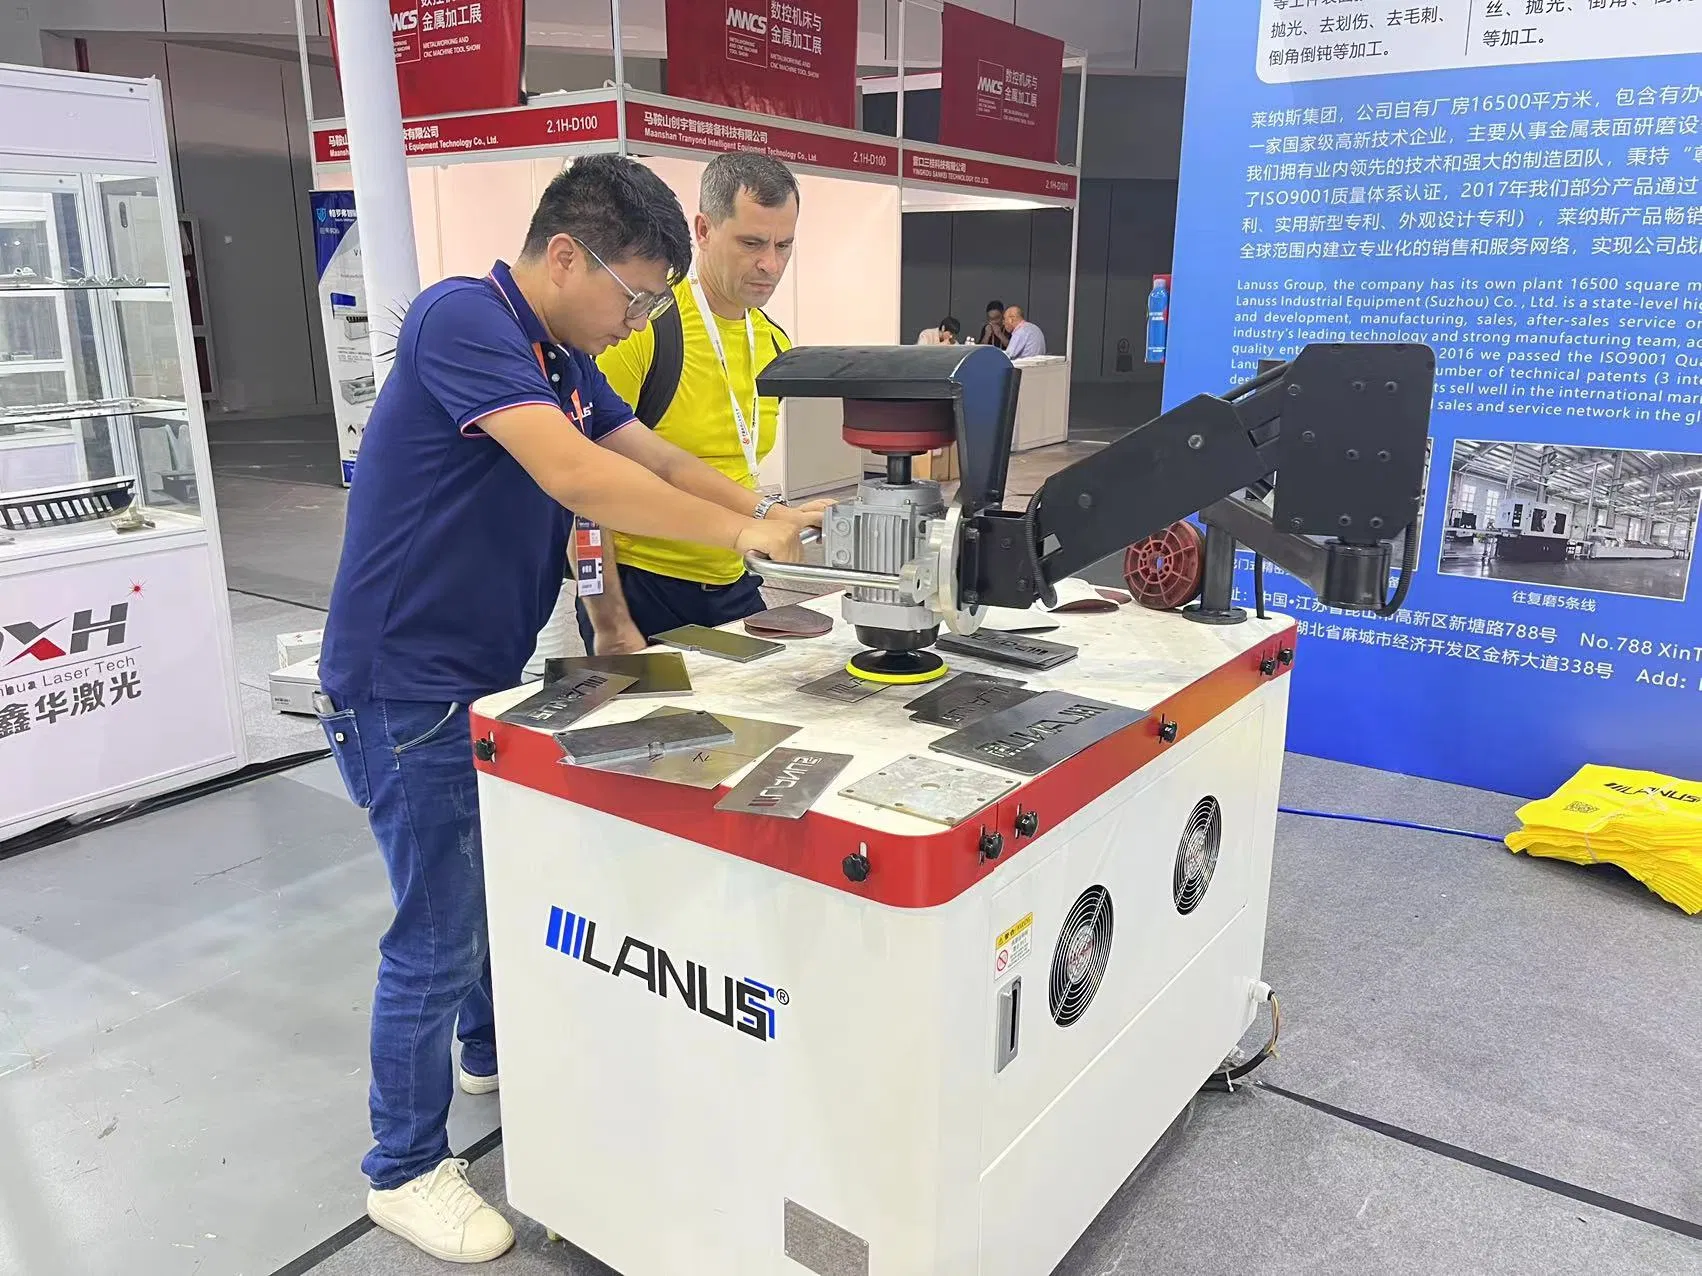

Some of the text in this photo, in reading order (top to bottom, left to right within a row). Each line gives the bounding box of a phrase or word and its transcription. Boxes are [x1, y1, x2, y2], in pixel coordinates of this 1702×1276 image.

[422, 3, 482, 32] 金属加工展
[770, 0, 822, 32] 数控机床与
[770, 24, 822, 55] 金属加工展
[1482, 28, 1544, 47] 等加工。
[1269, 41, 1391, 66] 倒角倒钝等加工。
[546, 116, 597, 133] 2.1H-D100
[644, 111, 768, 144] 马鞍山创宇智能装备科技有限公司
[409, 140, 439, 152] Equipment
[439, 137, 473, 150] Technology
[473, 136, 486, 146] Co.,
[487, 135, 499, 144] Ltd.
[644, 128, 677, 141] Maanshan
[679, 133, 707, 145] Tranyond
[708, 137, 736, 150] Intelligent
[767, 146, 797, 160] Technology
[853, 151, 887, 167] 2.1H-D100
[1237, 279, 1279, 290] Lanuss
[1284, 279, 1327, 293] Group,
[1334, 279, 1355, 290] the
[1360, 280, 1424, 293] company
[1430, 278, 1454, 290] has
[1461, 278, 1479, 290] its
[1485, 280, 1516, 290] own
[1523, 278, 1563, 292] plant
[1571, 278, 1618, 290] 16500
[1625, 280, 1680, 293] square
[1236, 296, 1277, 306] Lanuss
[1281, 296, 1342, 307] Industrial
[1346, 296, 1420, 310] Equipment
[1425, 295, 1489, 309] (Suzhou)
[1530, 296, 1558, 308] Ltd.
[1563, 296, 1575, 308] is
[1579, 299, 1588, 308] a
[1592, 297, 1678, 309] state-level
[1234, 312, 1257, 322] and
[1264, 313, 1352, 325] development,
[1360, 313, 1467, 327] manufacturing,
[1477, 313, 1517, 327] sales,
[1527, 313, 1609, 327] after-sales
[1619, 315, 1676, 329] service
[1233, 328, 1294, 341] industry's
[1298, 328, 1345, 342] leading
[1432, 331, 1458, 342] and
[1463, 332, 1510, 346] strong
[1515, 332, 1631, 349] manufacturing
[1637, 335, 1680, 349] team,
[1232, 343, 1274, 356] quality
[1439, 347, 1474, 359] 2016
[1480, 351, 1500, 360] we
[1507, 350, 1560, 363] passed
[1568, 350, 1592, 363] the
[1600, 352, 1666, 365] ISO9001
[1435, 365, 1482, 377] umber
[1489, 366, 1504, 378] of
[1510, 367, 1579, 381] technical
[1587, 371, 1647, 383] patents
[1654, 371, 1669, 385] (3
[1450, 382, 1474, 394] sell
[1478, 383, 1507, 395] well
[1512, 384, 1525, 396] in
[1530, 385, 1554, 397] the
[1560, 386, 1662, 402] international
[1437, 399, 1472, 411] sales
[1477, 401, 1504, 413] and
[1508, 403, 1562, 415] service
[1567, 406, 1631, 419] network
[1636, 407, 1649, 420] in
[1655, 408, 1680, 421] the
[1511, 590, 1597, 612] 往复磨5条线
[0, 602, 128, 667] XH
[43, 667, 90, 687] Laser
[94, 656, 135, 673] Tech
